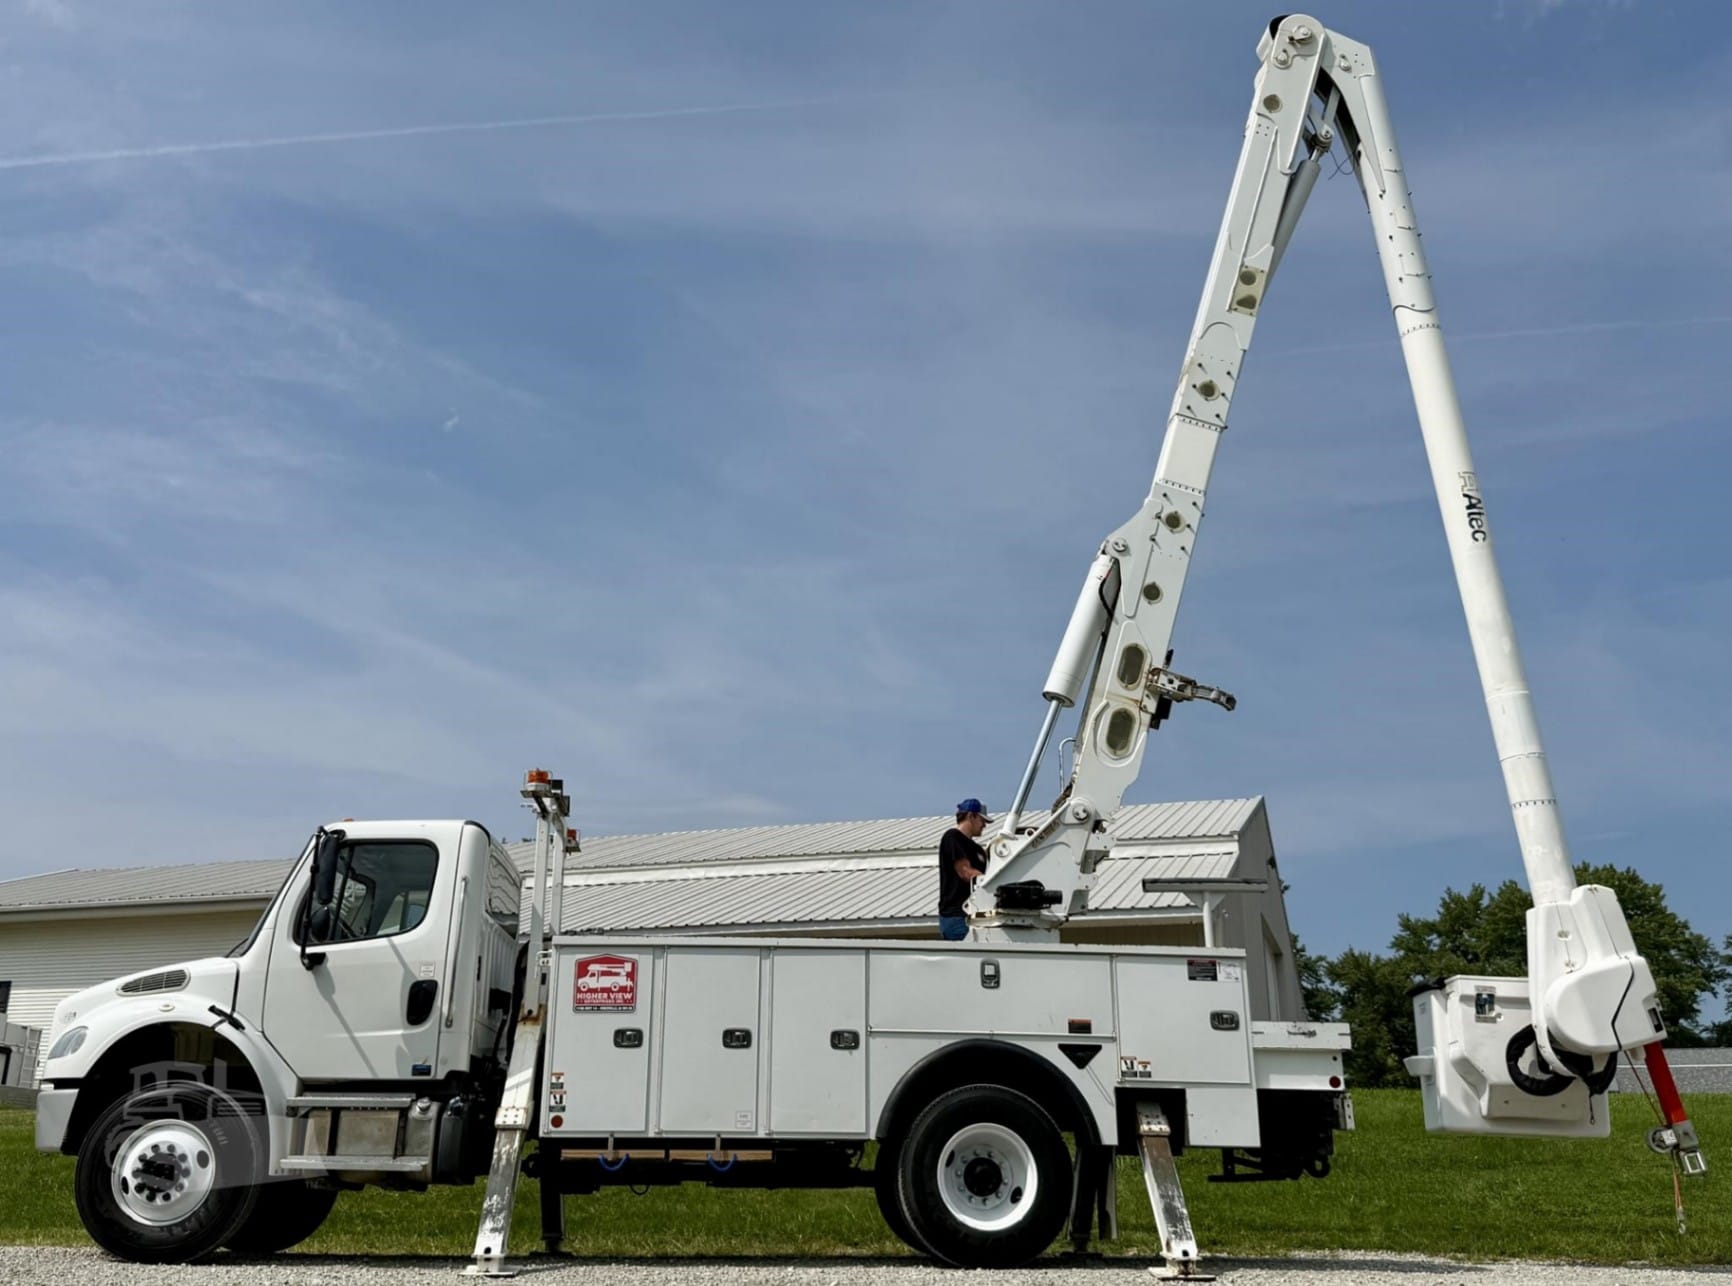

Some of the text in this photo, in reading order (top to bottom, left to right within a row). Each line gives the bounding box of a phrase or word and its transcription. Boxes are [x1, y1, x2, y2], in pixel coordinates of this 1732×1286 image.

[1462, 493, 1487, 542] Altec
[577, 992, 633, 1000] HIGHER VIEW
